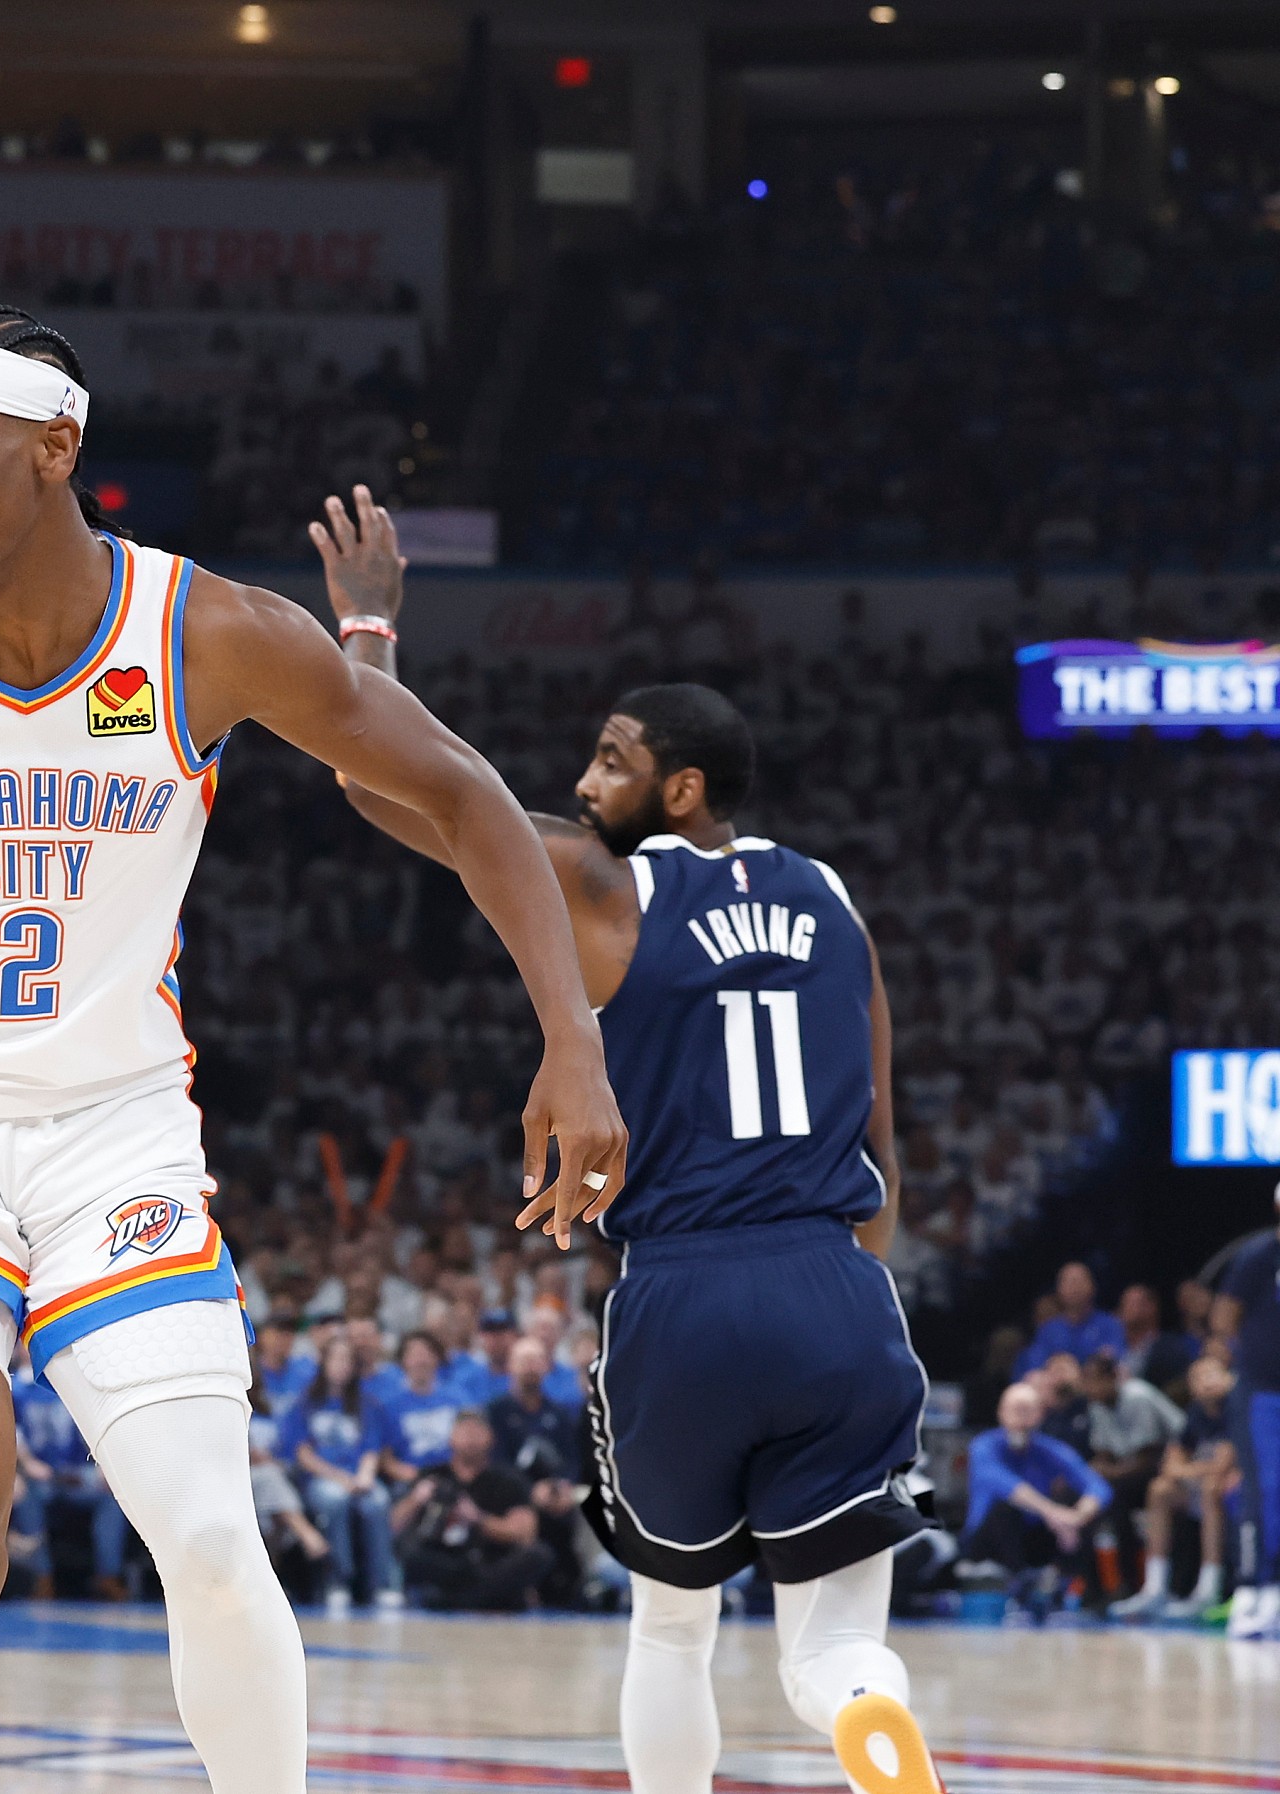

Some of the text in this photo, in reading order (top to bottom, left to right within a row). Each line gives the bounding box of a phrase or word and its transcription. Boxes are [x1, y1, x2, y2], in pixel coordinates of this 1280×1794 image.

[154, 226, 383, 283] TERRACE
[1053, 665, 1280, 715] THE BEST
[687, 902, 817, 965] IRVING
[716, 990, 812, 1140] 11
[110, 1203, 168, 1257] OKC
